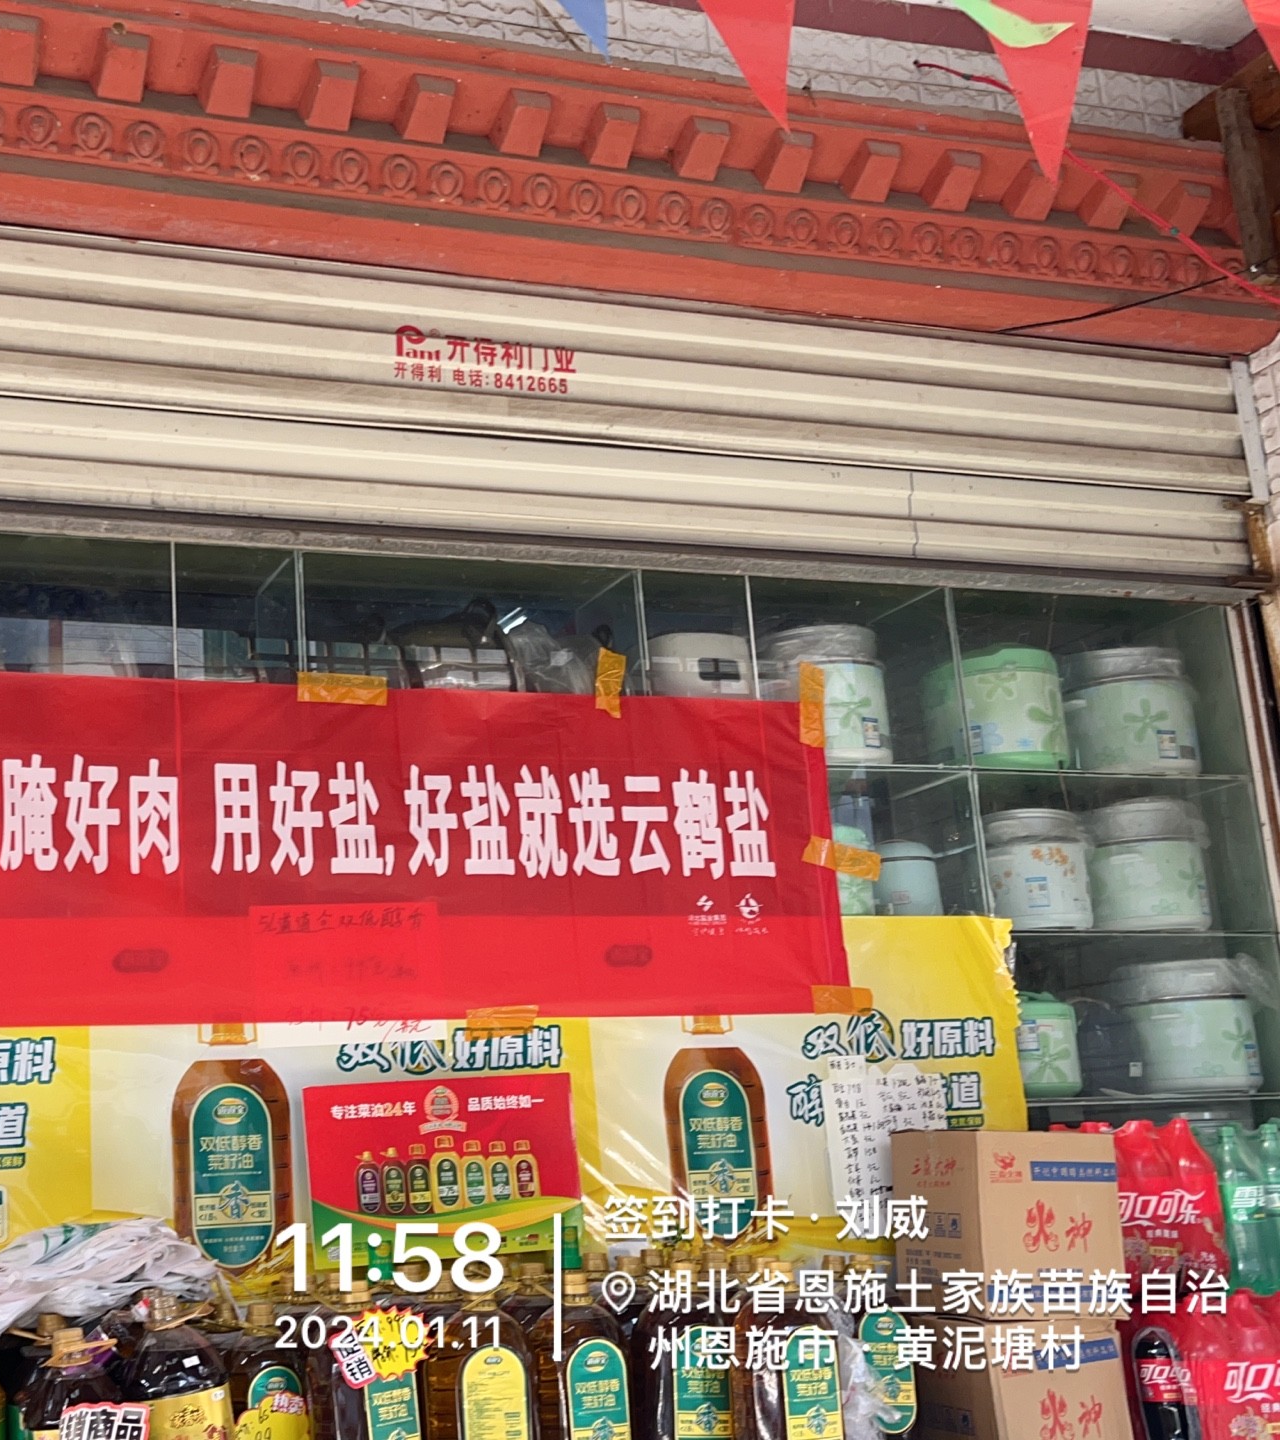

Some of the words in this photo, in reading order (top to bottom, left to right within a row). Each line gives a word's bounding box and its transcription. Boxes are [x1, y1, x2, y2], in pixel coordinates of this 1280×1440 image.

[444, 334, 577, 374] 开得利门业
[394, 361, 442, 383] 开得利
[452, 368, 569, 394] 电话:8412665
[211, 761, 779, 879] 用好盐,好盐就选云鹤盐
[329, 1101, 417, 1120] 专注菜油24年
[467, 1094, 545, 1112] 品质始终如一
[199, 1134, 263, 1152] 双低醇香
[207, 1153, 254, 1171] 菜籽油
[1022, 1199, 1093, 1253] 火神
